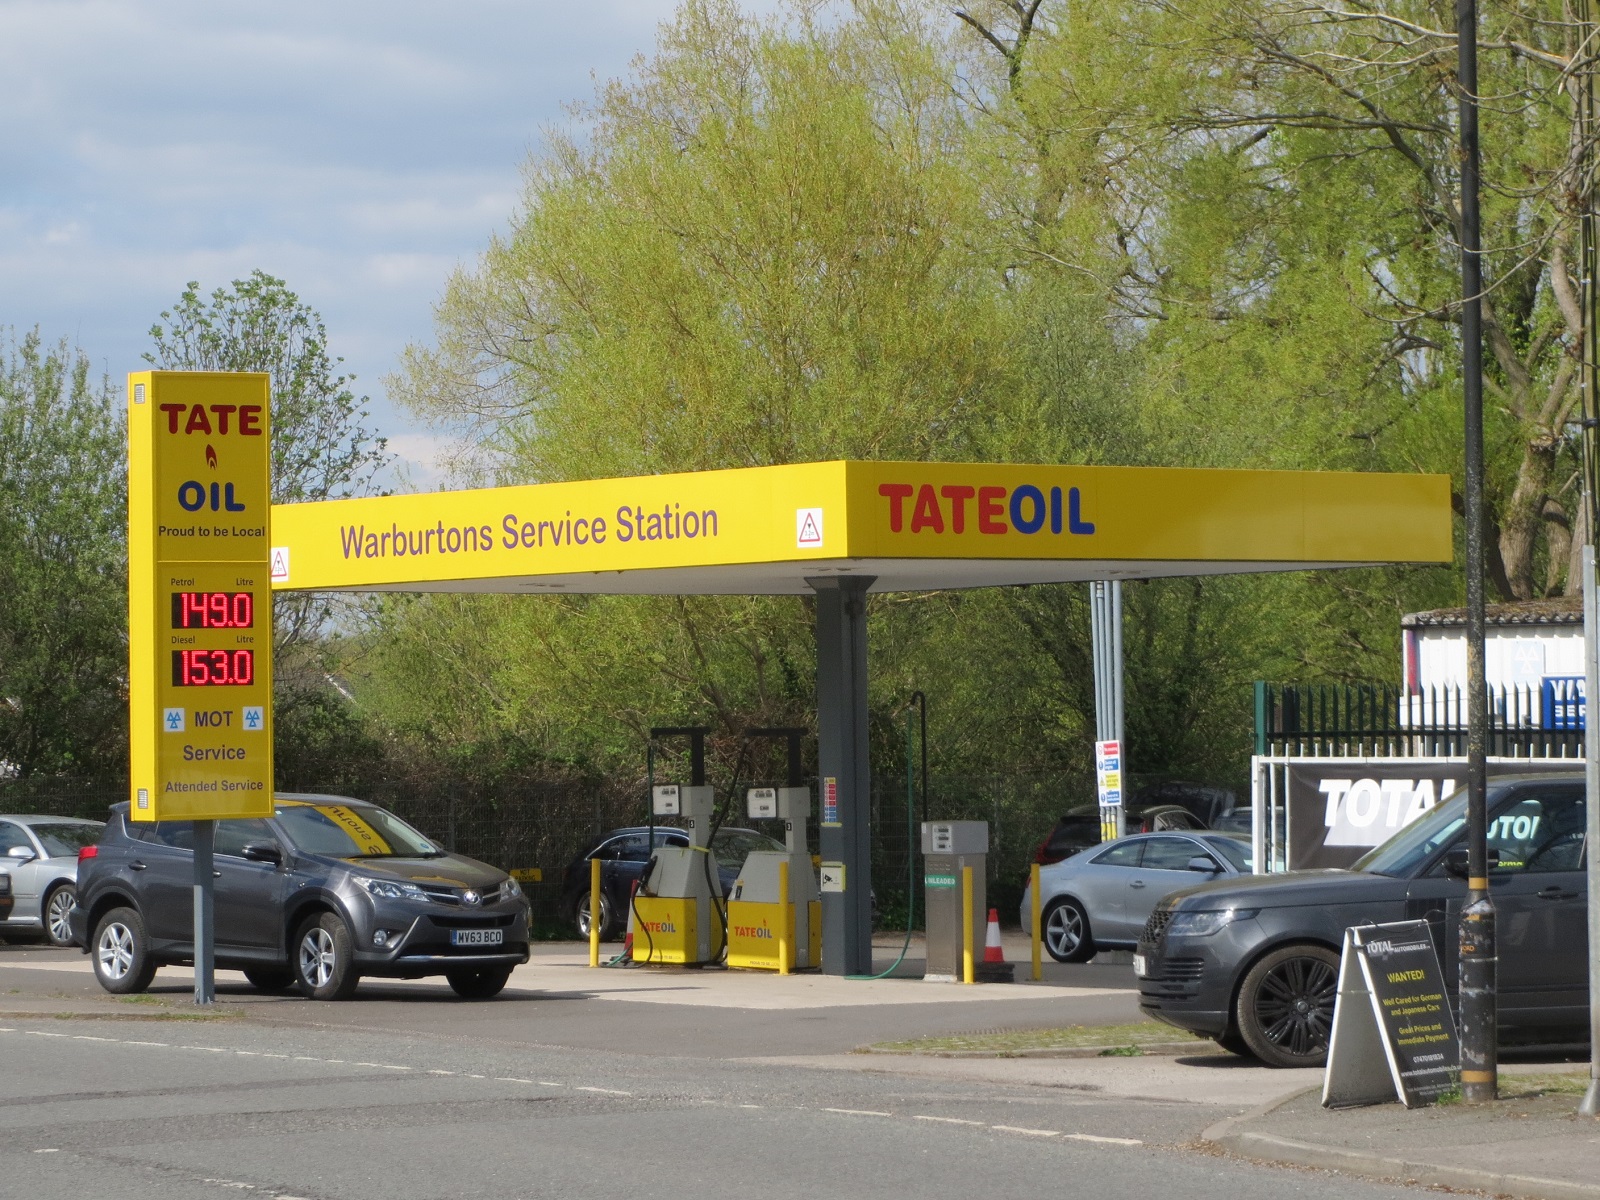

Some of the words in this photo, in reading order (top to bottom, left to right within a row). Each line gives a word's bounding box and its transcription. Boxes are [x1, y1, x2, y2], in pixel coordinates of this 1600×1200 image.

[160, 403, 262, 436] TATE
[178, 480, 245, 511] OIL
[878, 483, 1095, 534] TATEOIL
[158, 525, 195, 537] Proud
[198, 526, 210, 537] to
[213, 526, 229, 537] be
[232, 526, 265, 537] Local
[340, 519, 493, 560] Warburtons
[502, 513, 606, 549] Service
[616, 502, 718, 542] Station
[170, 578, 195, 586] Petrol
[236, 578, 254, 586] Litre
[181, 592, 252, 627] 149.0
[171, 635, 196, 644] Diesel
[236, 635, 254, 644] Litre
[182, 651, 252, 685] 153.0
[194, 711, 234, 727] MOT
[183, 745, 246, 761] Service
[165, 782, 218, 793] Attended
[221, 781, 264, 792] Service
[734, 926, 772, 938] TATEOIL
[1366, 940, 1394, 953] TOTAL
[1387, 969, 1425, 983] WANTED!
[1420, 993, 1442, 1002] German
[1402, 1006, 1427, 1016] Japanese
[1427, 1004, 1440, 1012] Cars
[1414, 1025, 1431, 1033] Prices
[1431, 1023, 1442, 1031] and
[1397, 1037, 1425, 1045] Immediate
[1425, 1033, 1449, 1043] Payment
